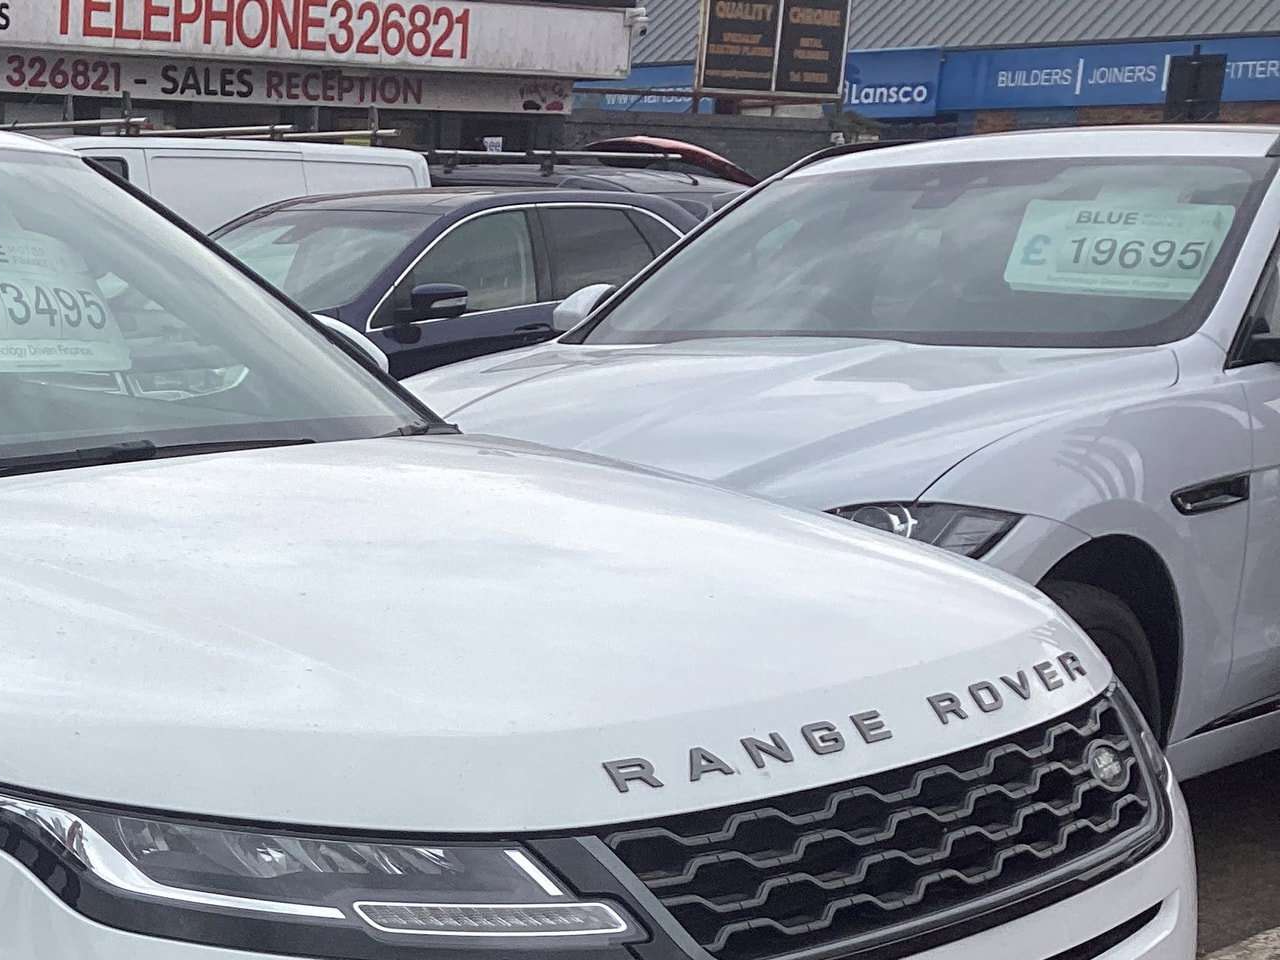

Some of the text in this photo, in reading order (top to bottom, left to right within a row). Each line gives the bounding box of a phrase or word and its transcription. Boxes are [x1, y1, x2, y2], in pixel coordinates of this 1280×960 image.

[716, 2, 772, 20] QUALITY
[6, 55, 121, 91] 326821
[161, 64, 253, 97] SALES
[266, 71, 423, 103] RECEPTION
[998, 69, 1071, 87] BUILDERS
[1088, 65, 1156, 84] JOINERS
[851, 83, 927, 104] Lansco
[1075, 211, 1139, 225] BLUE
[1071, 237, 1206, 270] 19695
[602, 651, 1088, 793] RANGE ROVER
